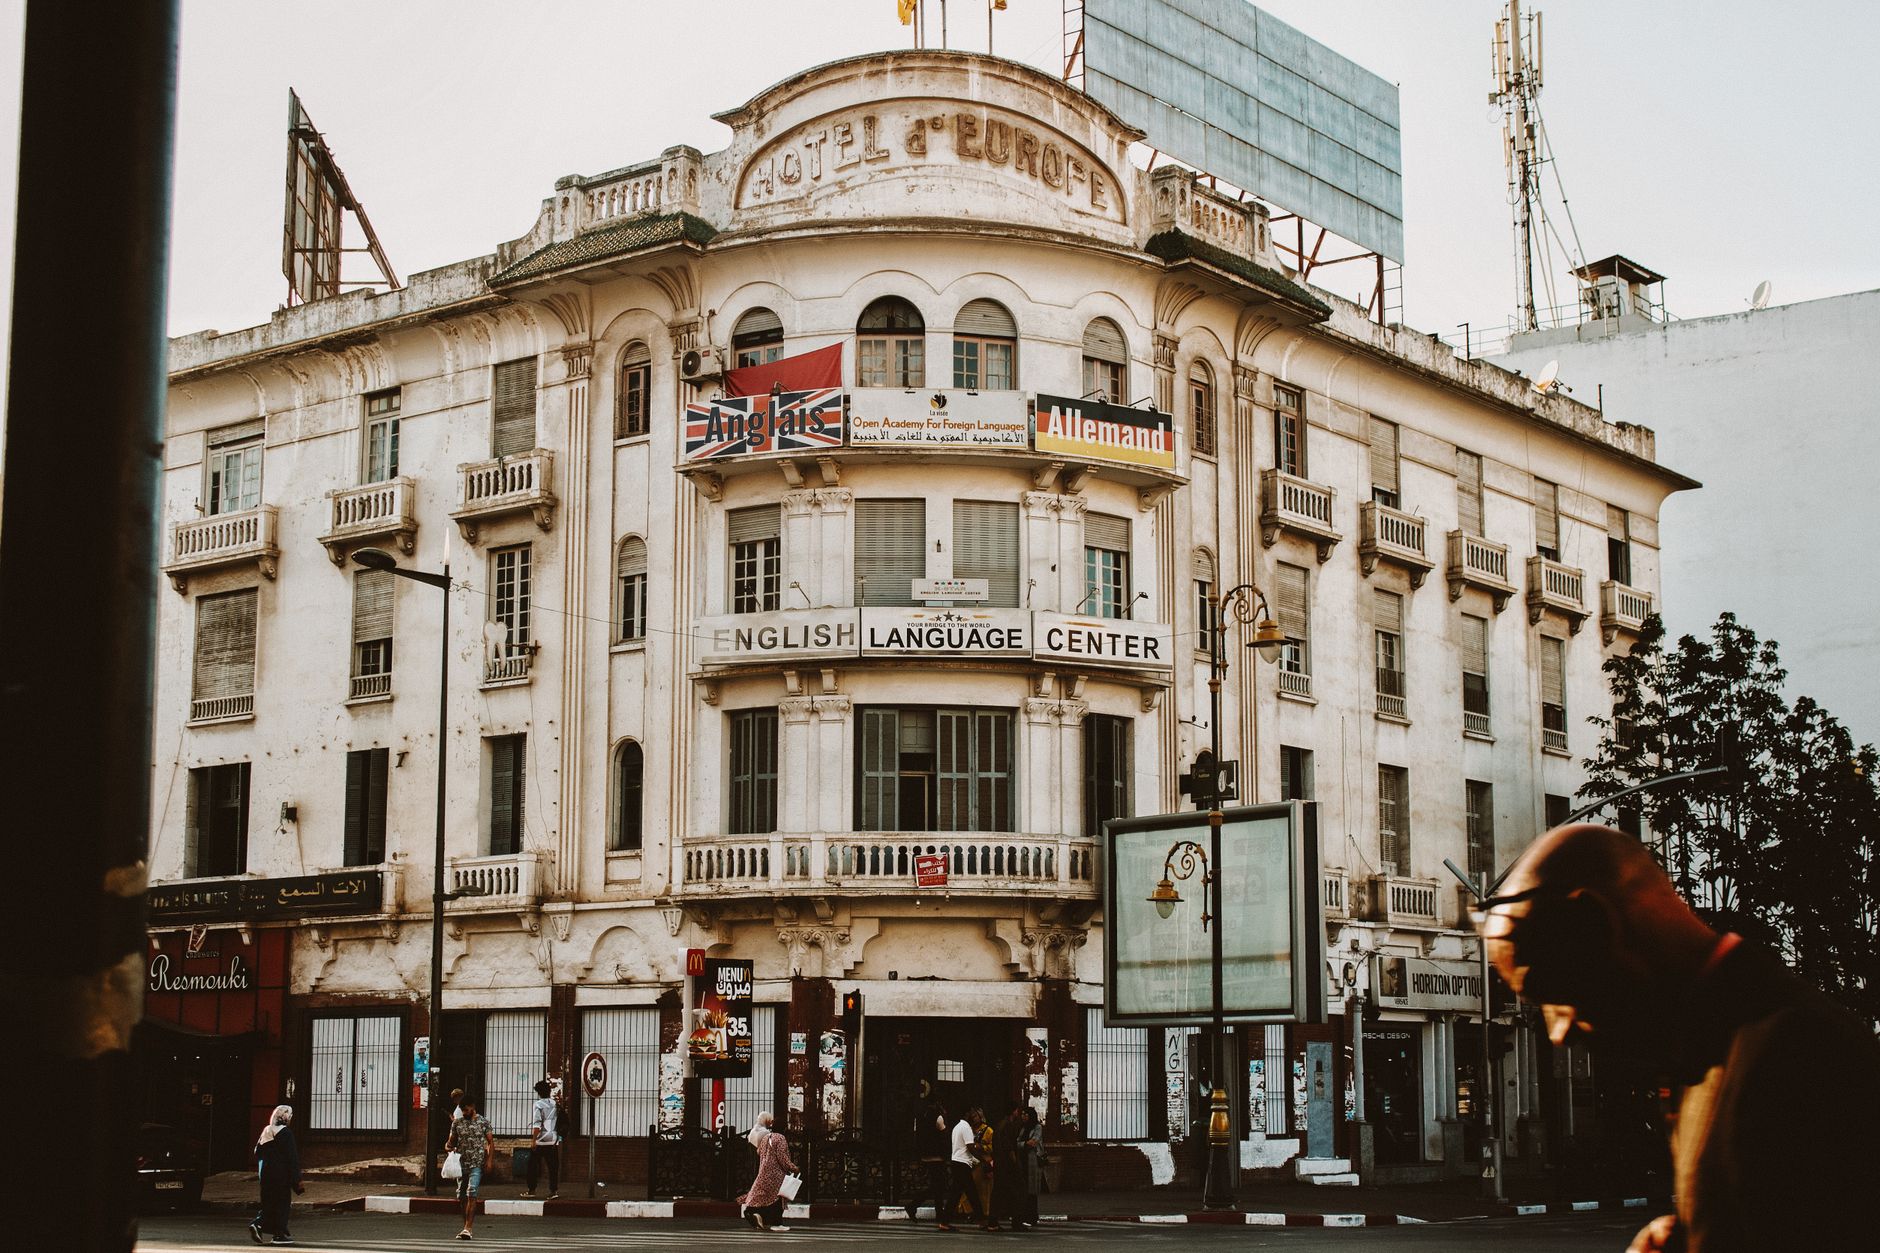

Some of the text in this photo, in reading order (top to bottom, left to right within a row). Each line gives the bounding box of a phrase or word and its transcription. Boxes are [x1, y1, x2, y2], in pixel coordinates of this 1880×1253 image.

[752, 115, 890, 199] HOTEL
[704, 400, 826, 449] Anglais
[853, 416, 1025, 432] Open Academy For Foreign Languages
[1047, 405, 1165, 455] Allemand
[713, 622, 1161, 660] ENGLISH LANGUAGE CENTER
[150, 954, 248, 991] Resmouki
[718, 967, 743, 982] MENU
[716, 981, 751, 1000] مبروك
[1412, 973, 1483, 999] HORIZON OPTIQU
[727, 1016, 748, 1037] 35
[1386, 1032, 1411, 1040] DESIGN
